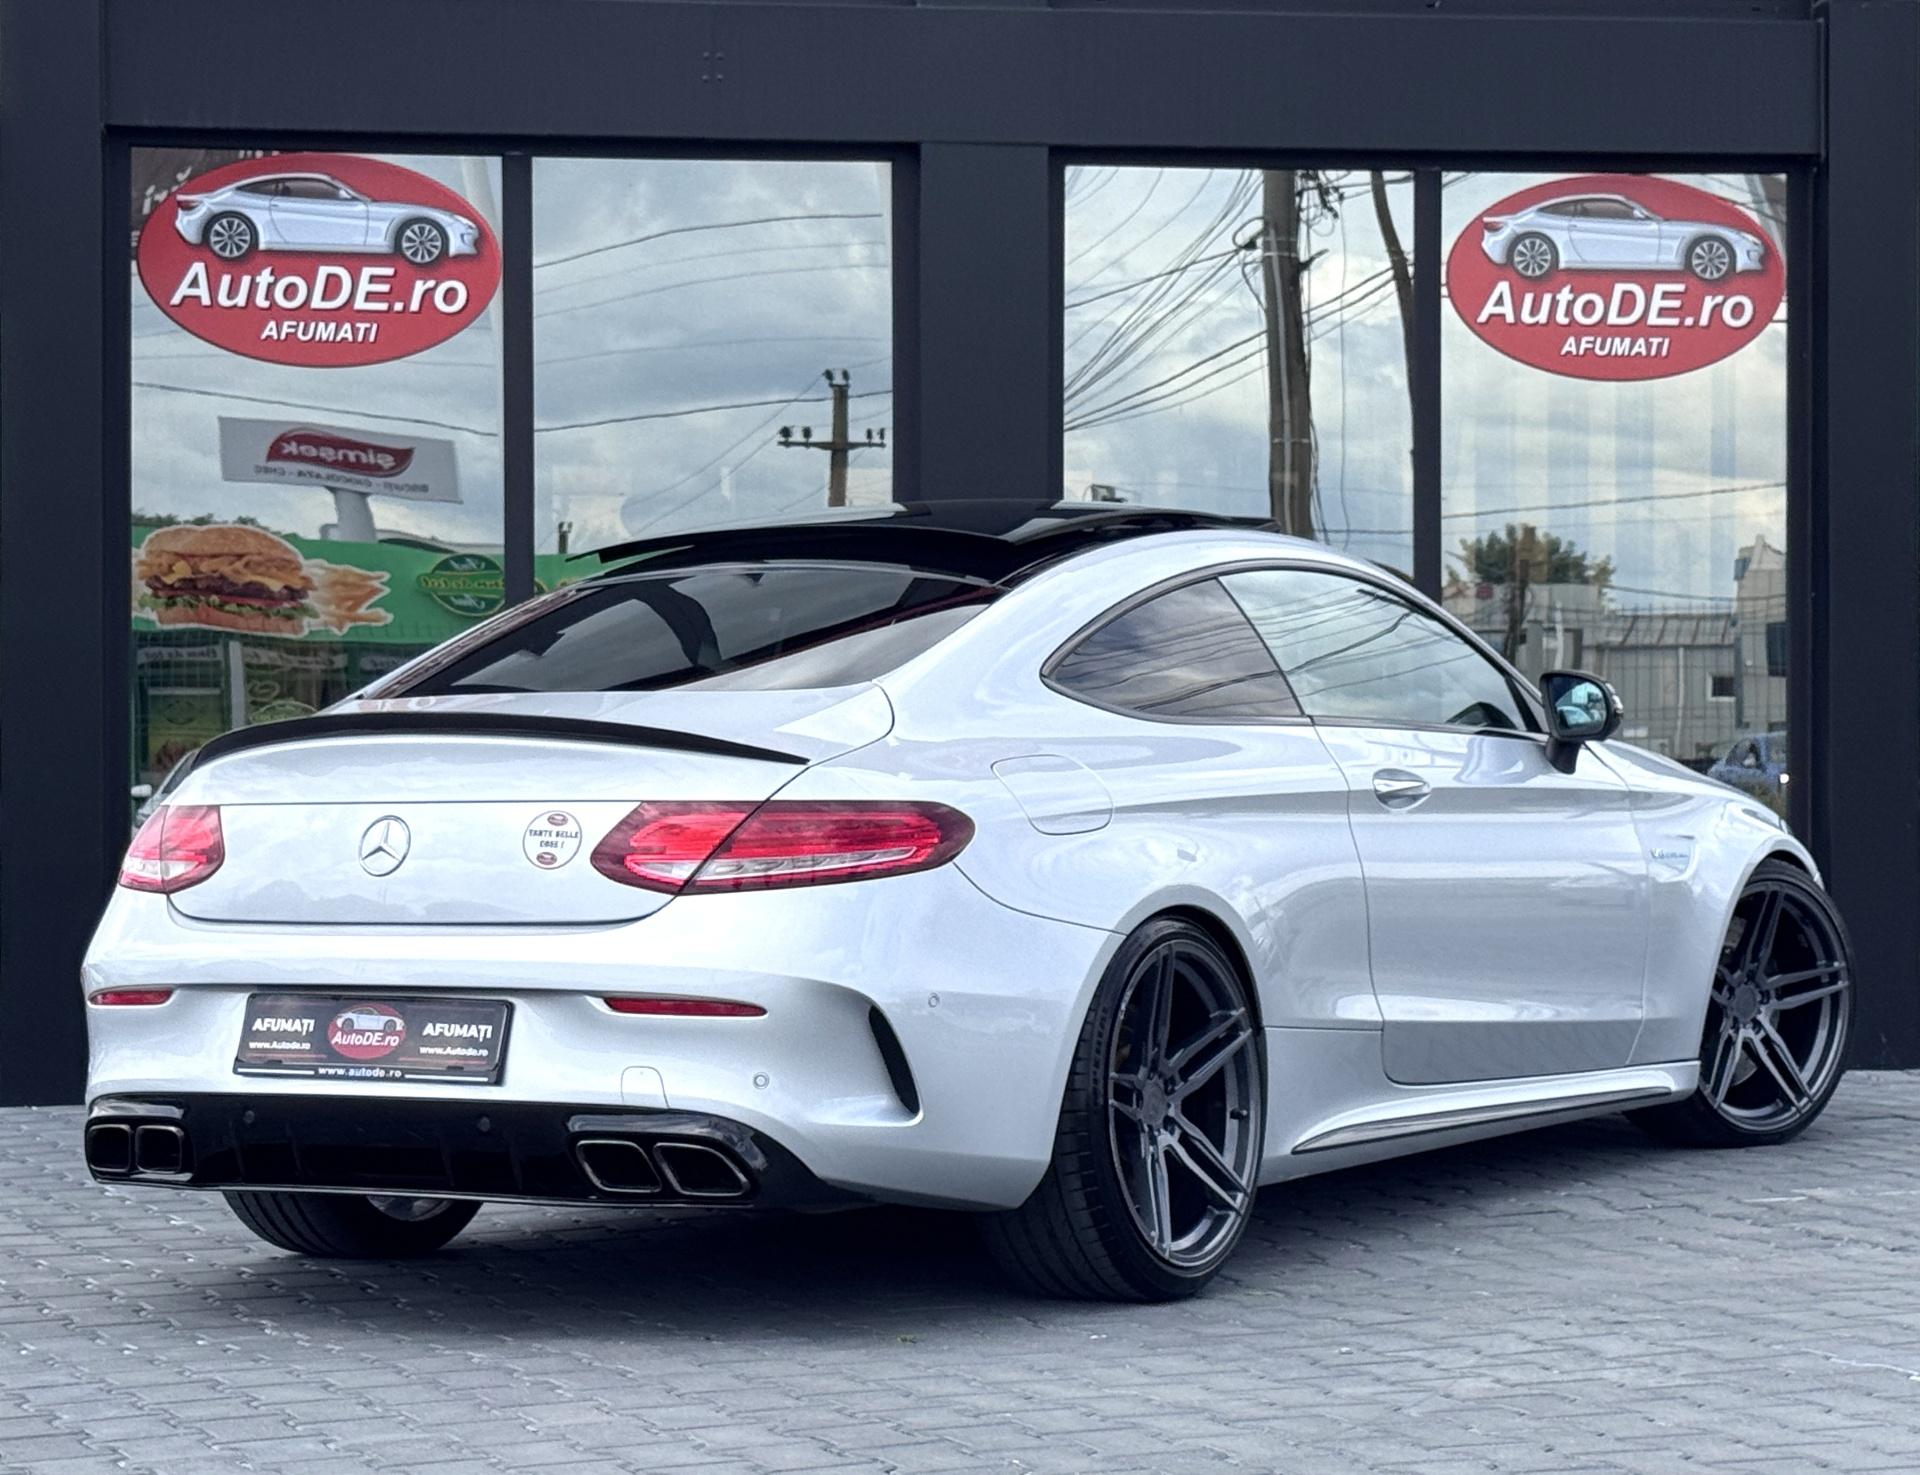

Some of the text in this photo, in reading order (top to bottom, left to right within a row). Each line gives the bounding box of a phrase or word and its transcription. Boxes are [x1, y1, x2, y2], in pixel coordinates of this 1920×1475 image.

[169, 262, 468, 314] AutoDE.ro
[1476, 280, 1755, 329] AutoDE.ro
[260, 320, 379, 342] AFUMATI
[1560, 336, 1670, 358] AFUMATI
[331, 1030, 400, 1047] AutoDE.ro
[318, 1067, 402, 1078] www.autode.ro
